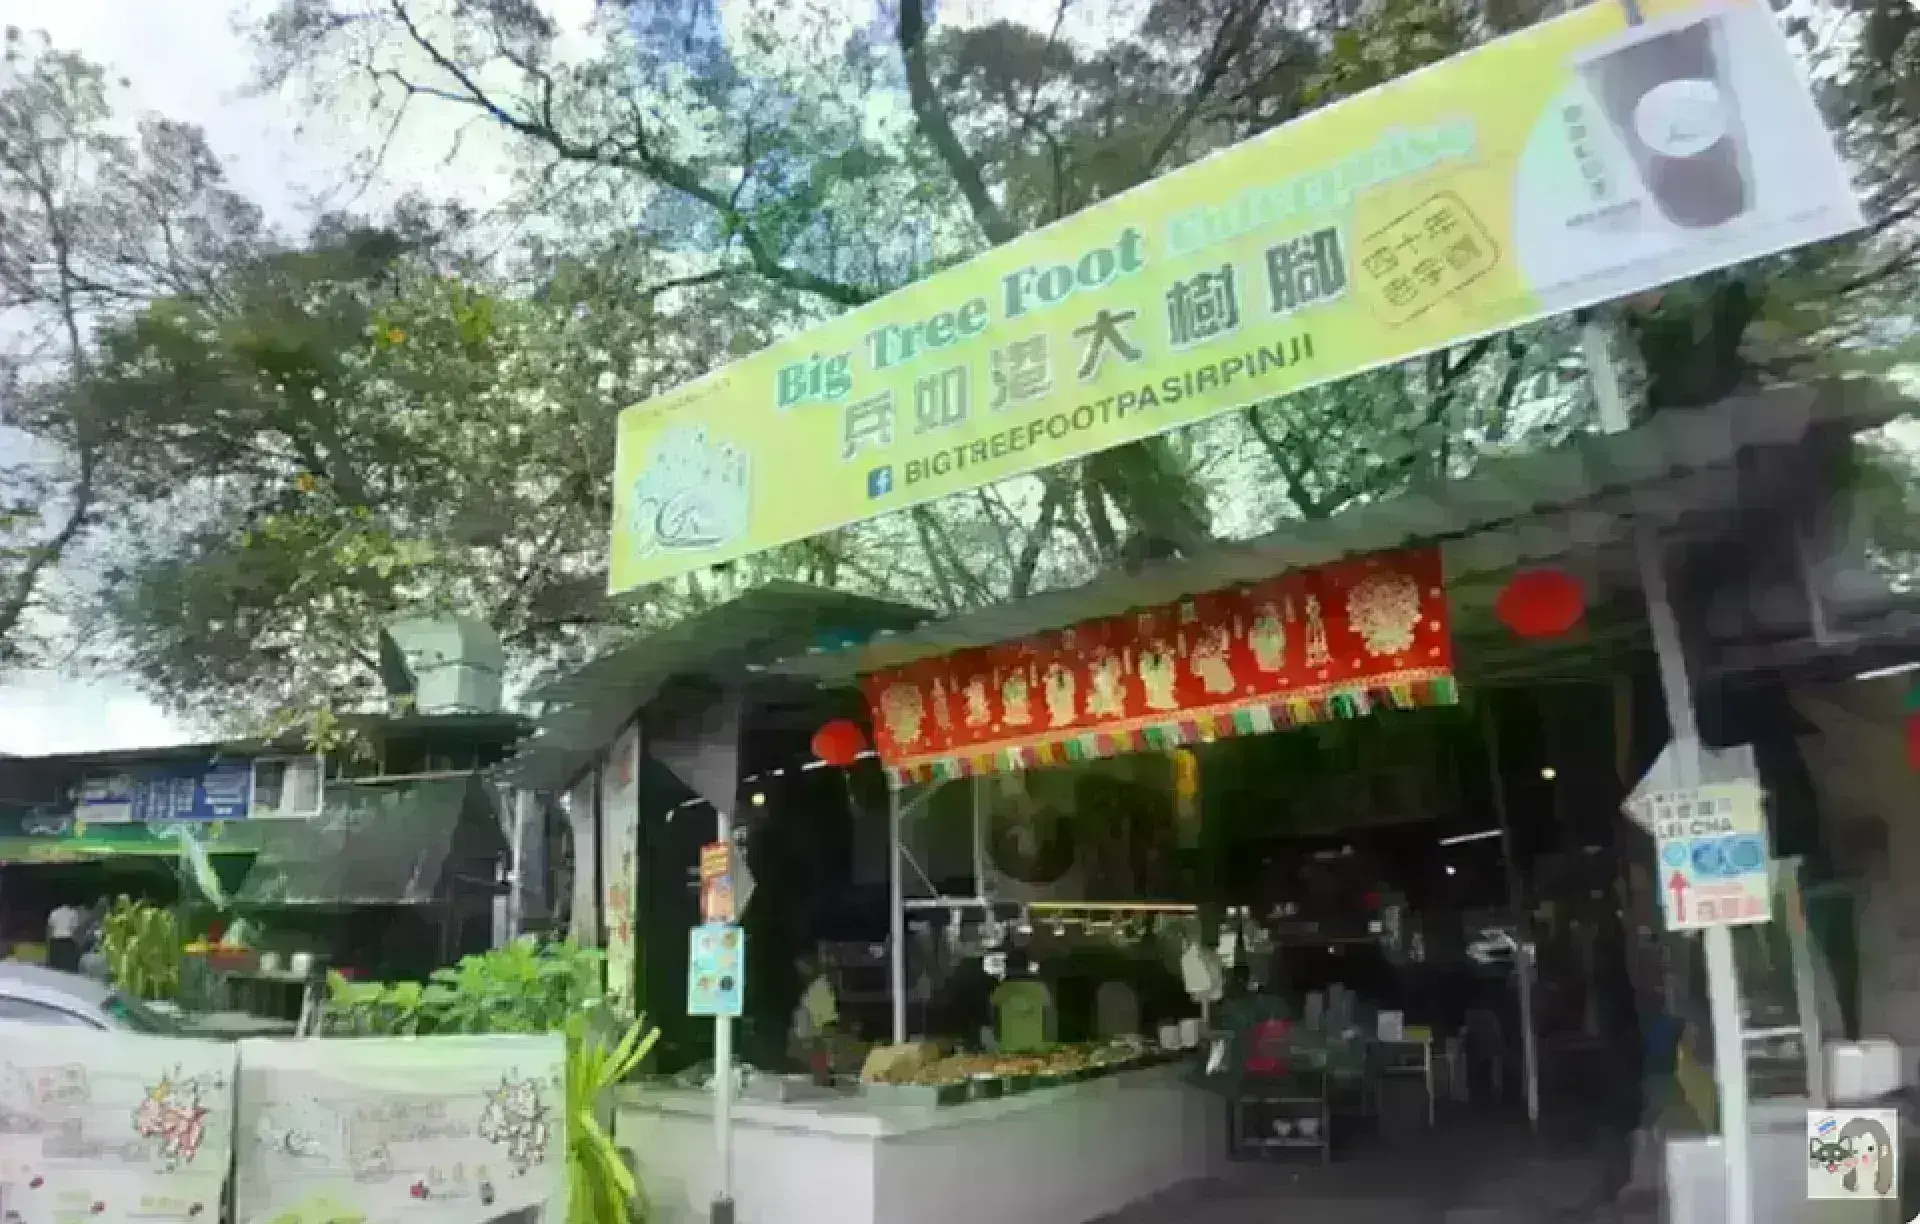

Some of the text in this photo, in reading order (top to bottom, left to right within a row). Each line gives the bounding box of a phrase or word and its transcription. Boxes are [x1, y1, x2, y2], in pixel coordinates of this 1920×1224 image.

[776, 350, 852, 408] Big
[864, 297, 990, 370] Tree
[1001, 226, 1145, 318] Foot
[903, 333, 1315, 485] BIGTREEFOOTPASIRPINJI
